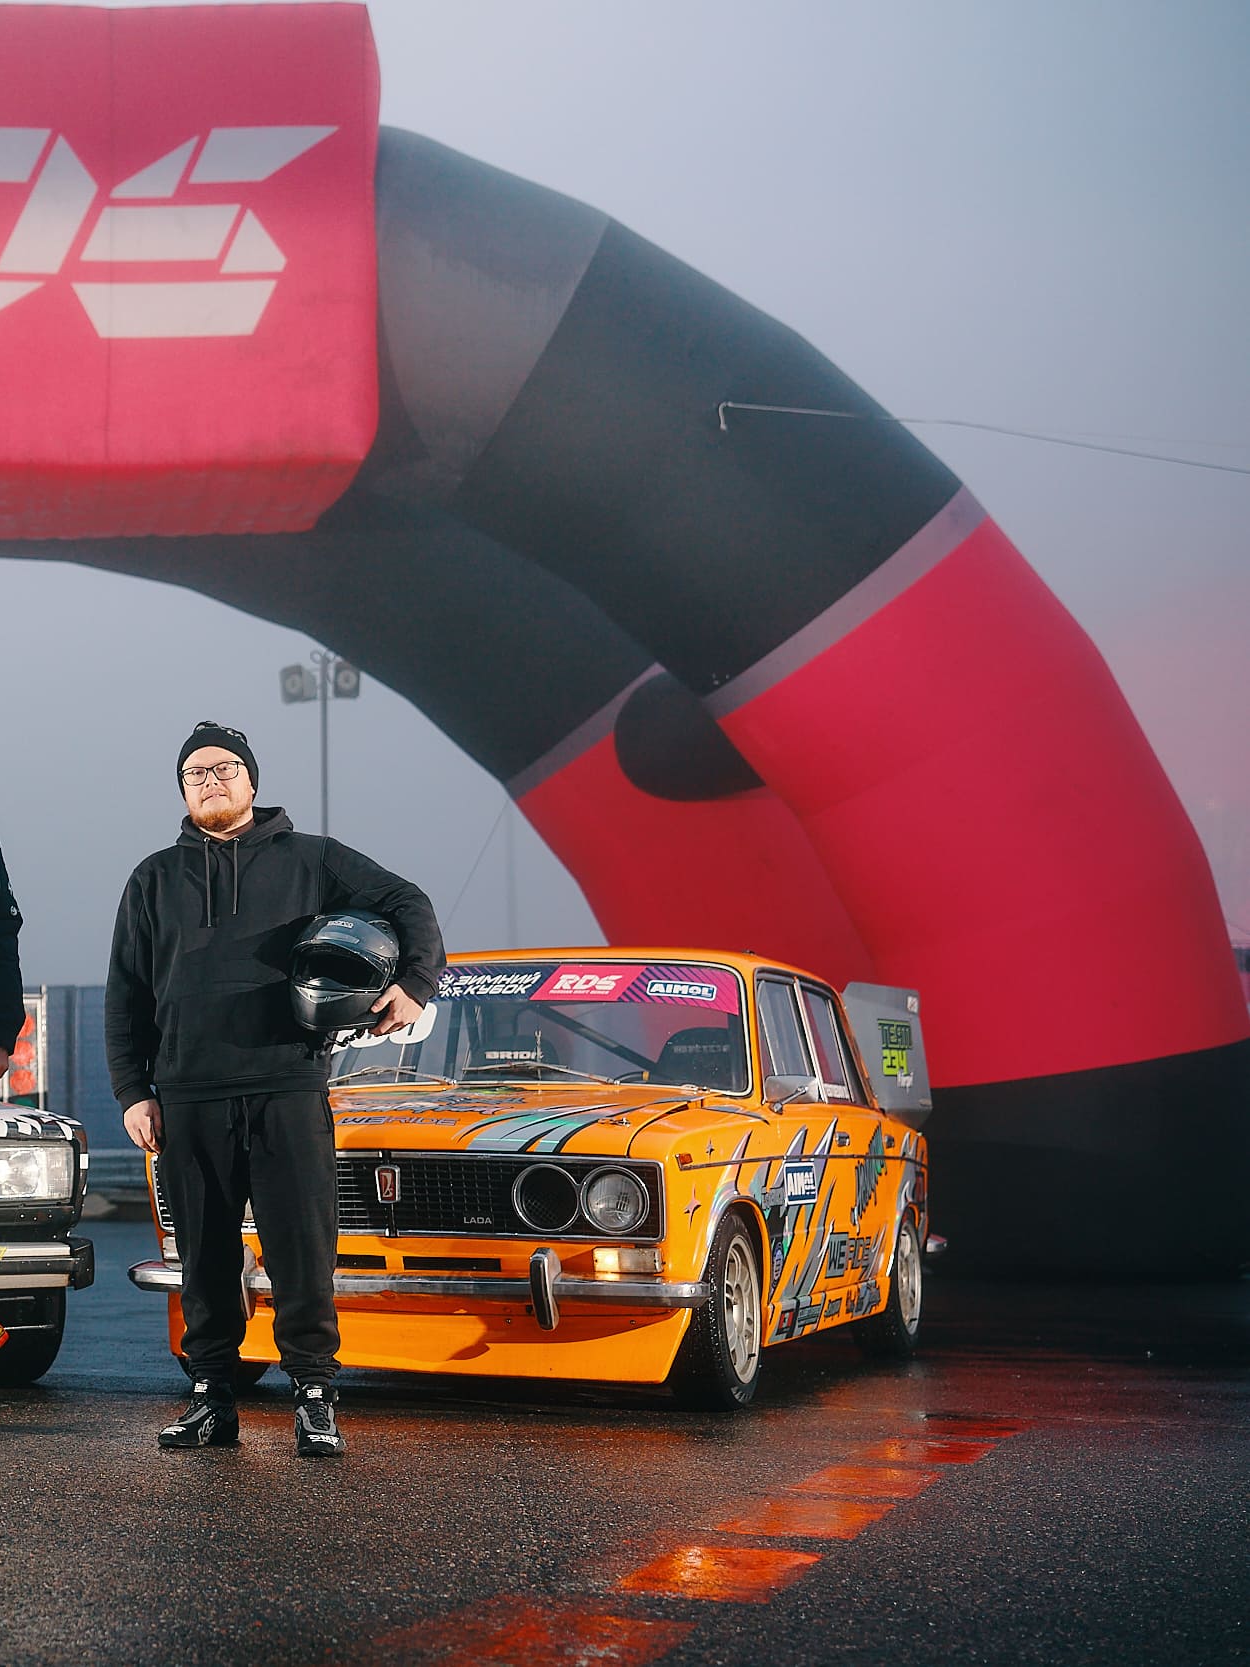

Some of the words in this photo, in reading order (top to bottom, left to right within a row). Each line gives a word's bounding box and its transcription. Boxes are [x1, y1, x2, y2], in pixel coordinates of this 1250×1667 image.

[454, 971, 541, 985] ЗИМНИЙ
[553, 974, 622, 991] RDS
[463, 984, 533, 995] КУБОК
[650, 983, 714, 998] AIMOL
[463, 1216, 493, 1225] LADA
